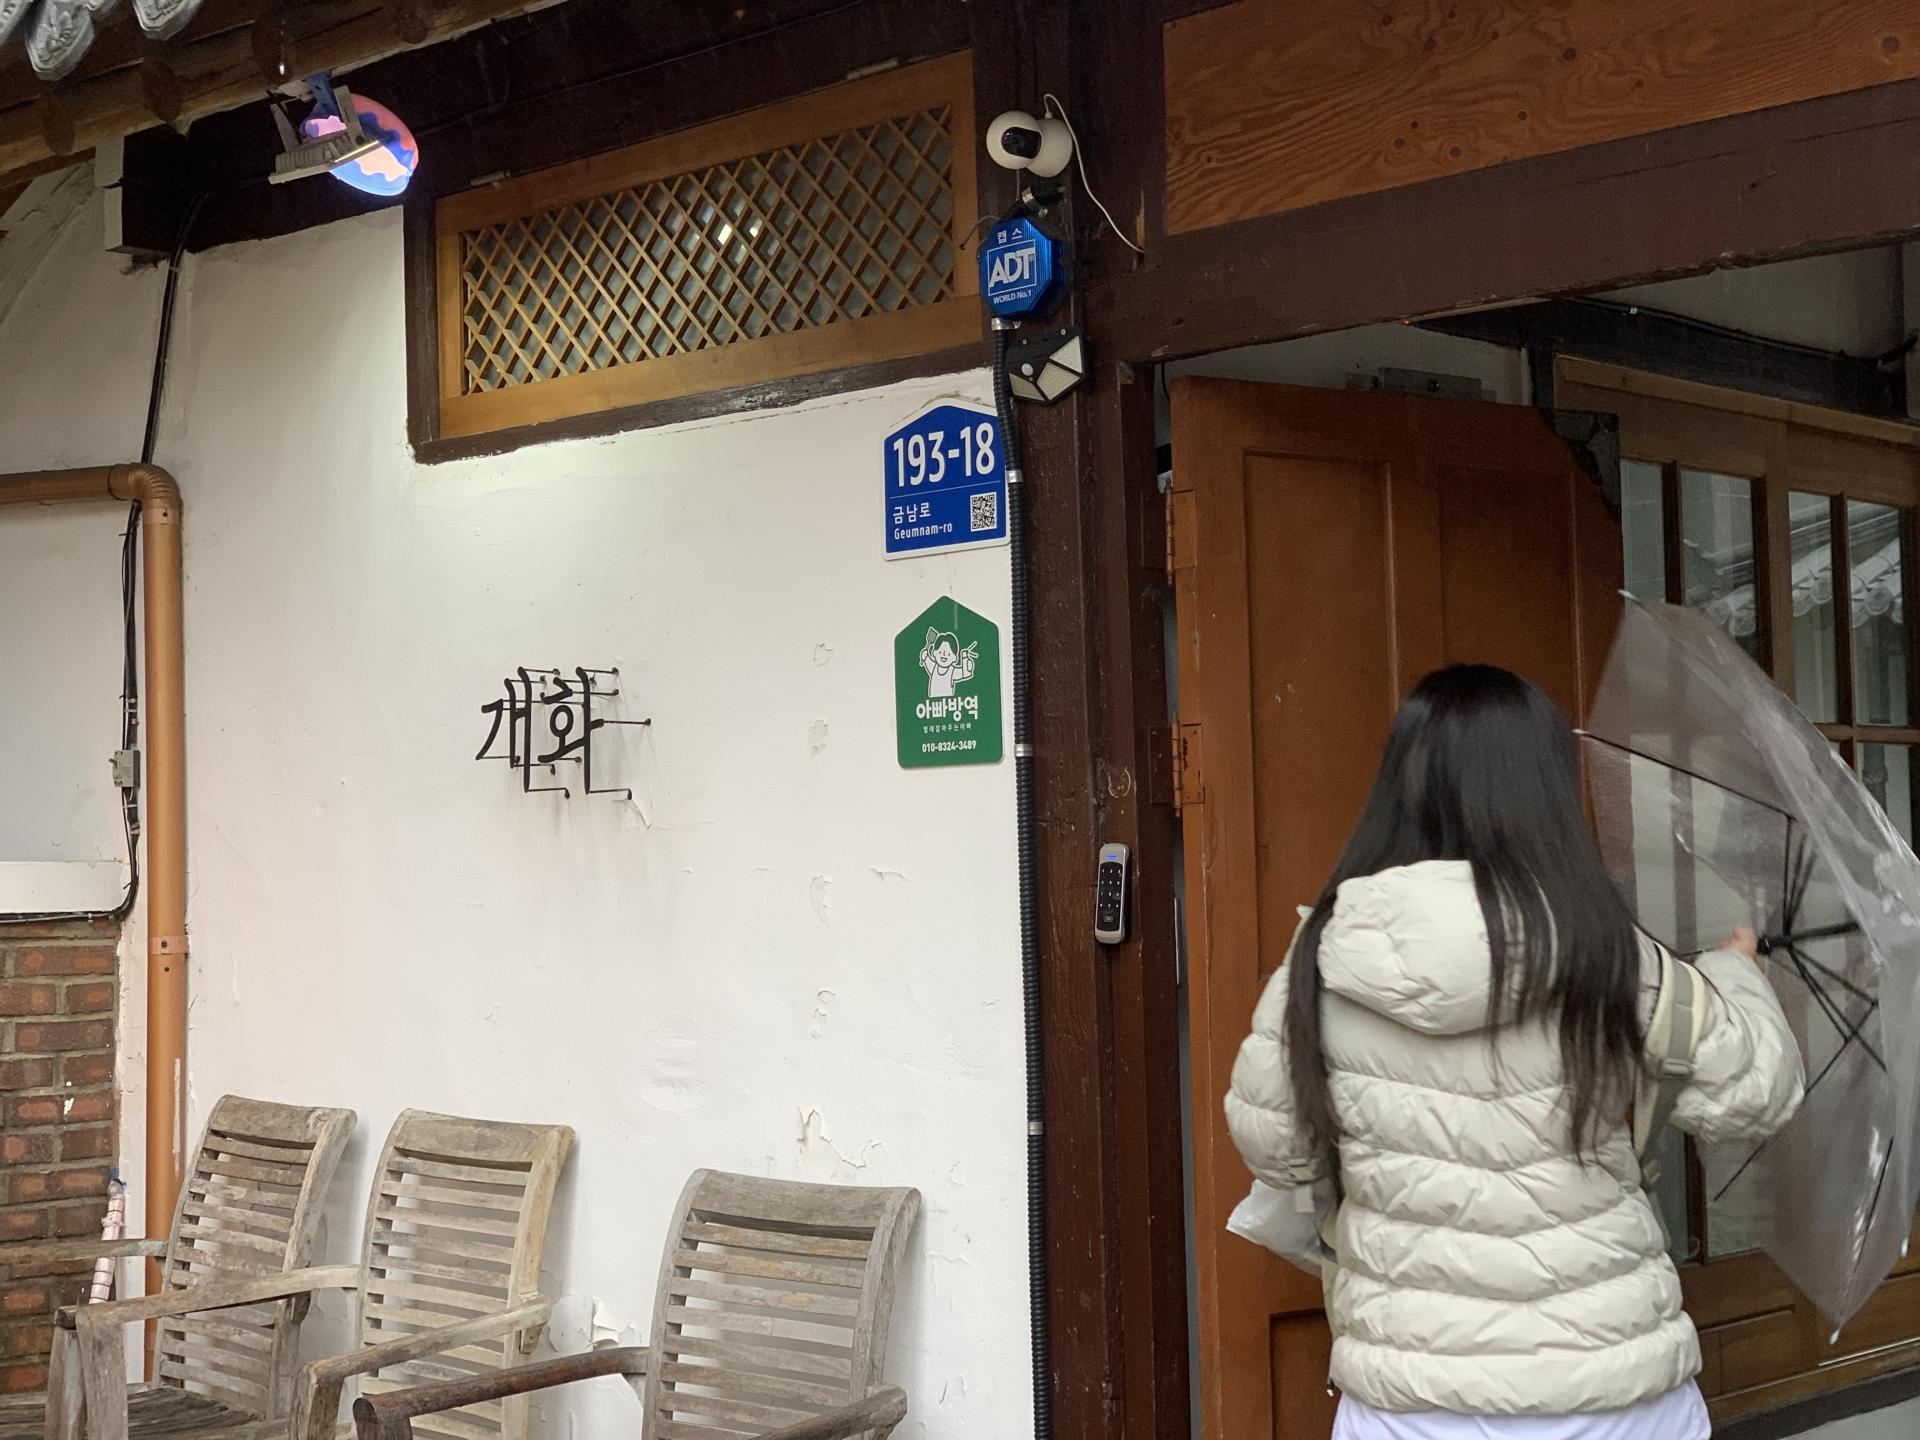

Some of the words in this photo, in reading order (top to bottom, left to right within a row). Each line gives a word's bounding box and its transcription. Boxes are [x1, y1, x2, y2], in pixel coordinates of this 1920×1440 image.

[997, 228, 1023, 244] 캡스
[988, 247, 1035, 288] ADT
[993, 294, 1016, 304] WORLD
[1017, 289, 1032, 299] No.1
[893, 422, 995, 487] 193-18
[893, 502, 931, 524] 금남로
[894, 523, 953, 540] Geumnam-ro
[915, 695, 979, 722] 아빠방역
[475, 666, 604, 795] 개화
[921, 740, 977, 753] 010-8324-3489
